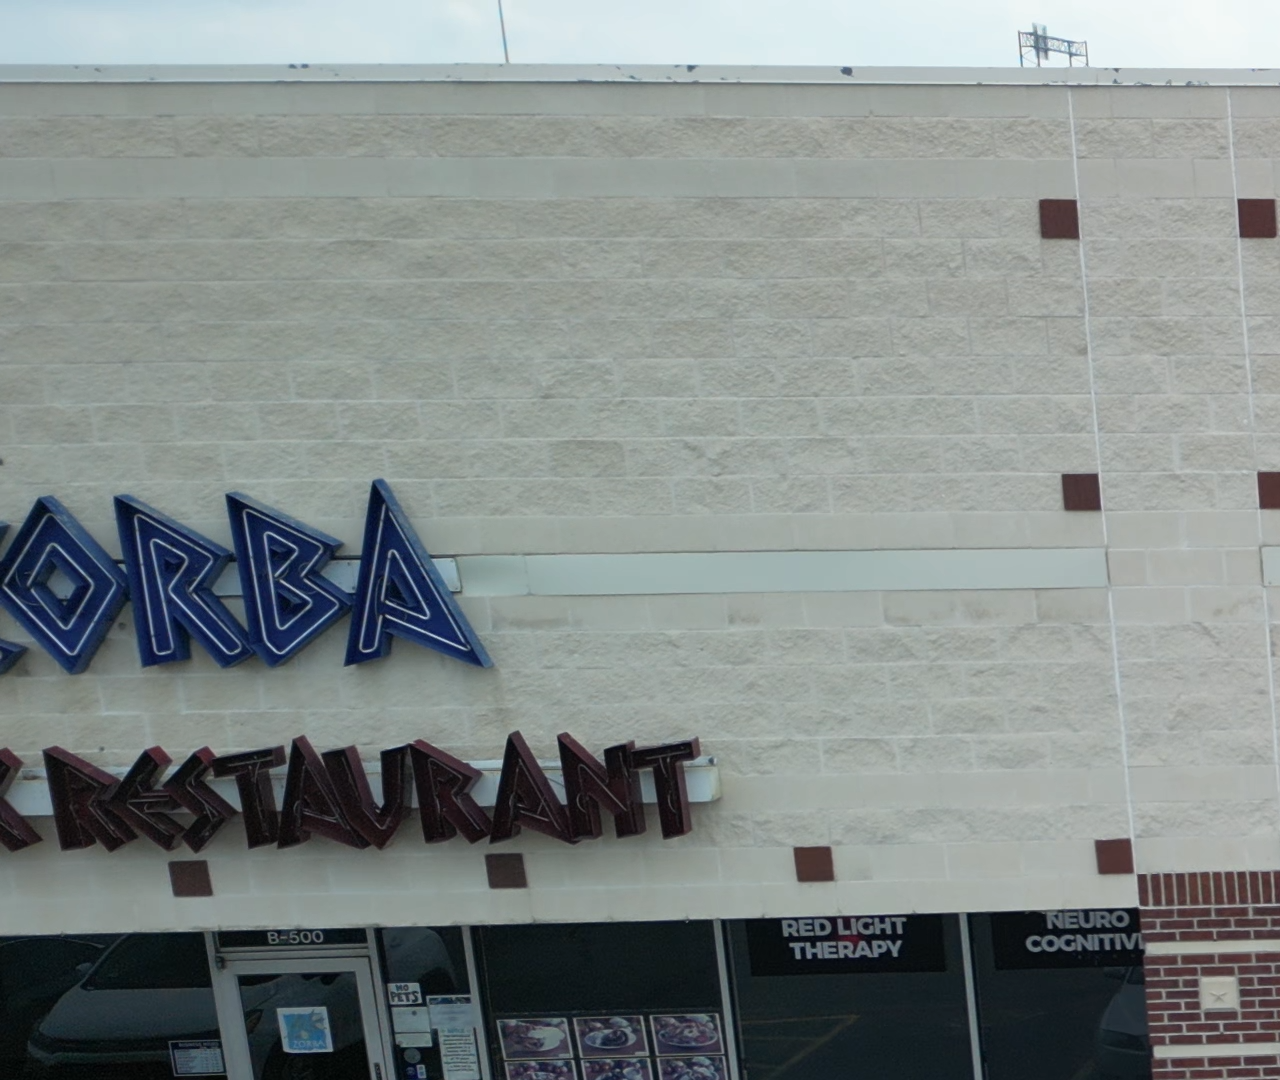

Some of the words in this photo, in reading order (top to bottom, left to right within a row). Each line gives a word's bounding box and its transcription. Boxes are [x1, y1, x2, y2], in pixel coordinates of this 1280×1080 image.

[0, 478, 492, 675] ORBA
[42, 731, 698, 853] RESTAURANT
[782, 918, 832, 937] RED
[838, 916, 907, 936] LIGHT
[1046, 910, 1130, 929] NEURO
[267, 930, 324, 945] B-500
[789, 940, 902, 960] THERAPY
[390, 991, 420, 1003] PETS
[293, 1040, 325, 1048] ZORBA
